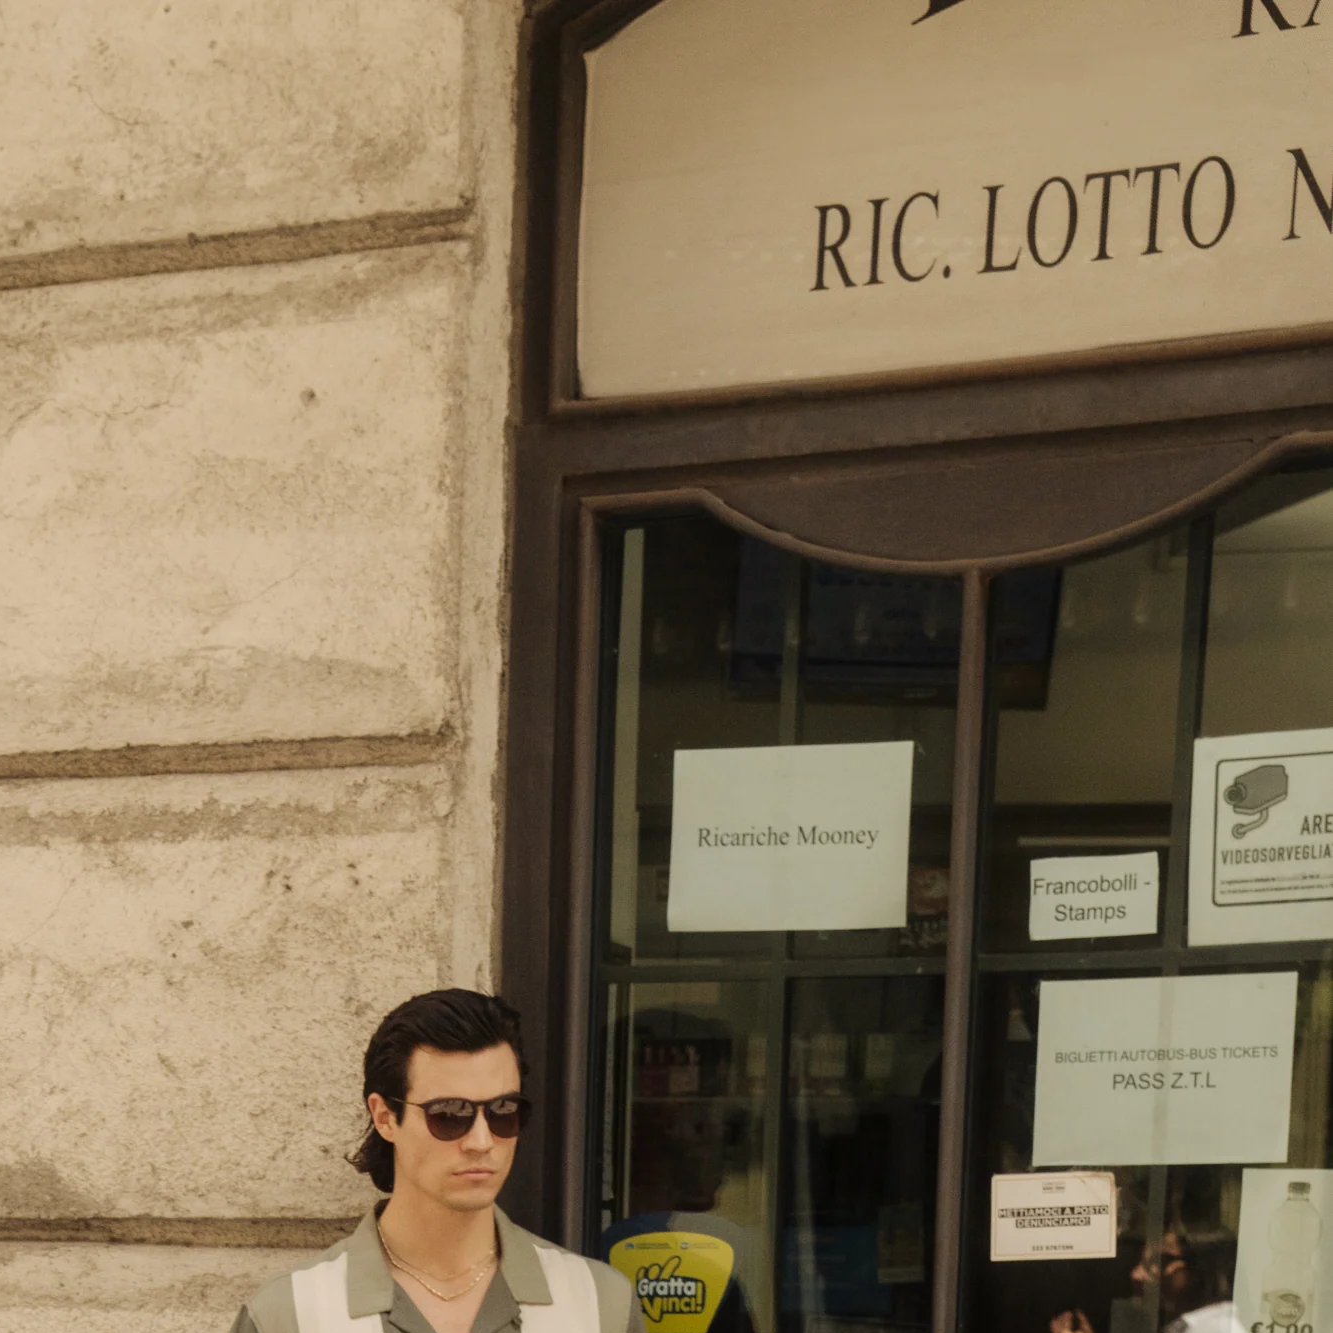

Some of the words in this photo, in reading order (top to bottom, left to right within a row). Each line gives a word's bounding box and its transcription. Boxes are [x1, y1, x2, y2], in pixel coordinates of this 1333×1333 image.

[809, 189, 951, 293] RIC.
[977, 155, 1236, 274] LOTTO
[697, 826, 791, 848] Ricariche
[797, 825, 880, 850] Mooney
[1221, 843, 1333, 866] VIDEOSORVEGLIA
[1033, 872, 1138, 896] Francobolli
[1054, 903, 1127, 924] Stamps
[1055, 1050, 1116, 1064] BIGLIETTI
[1120, 1047, 1217, 1062] AUTOBUS-BUS
[1222, 1045, 1279, 1059] TICKETS
[1112, 1072, 1166, 1090] PASS
[1170, 1071, 1217, 1089] Z.T.L
[998, 1206, 1062, 1218] METTIAMOCI
[1073, 1205, 1108, 1216] POSTO
[638, 1278, 696, 1296] Gratta
